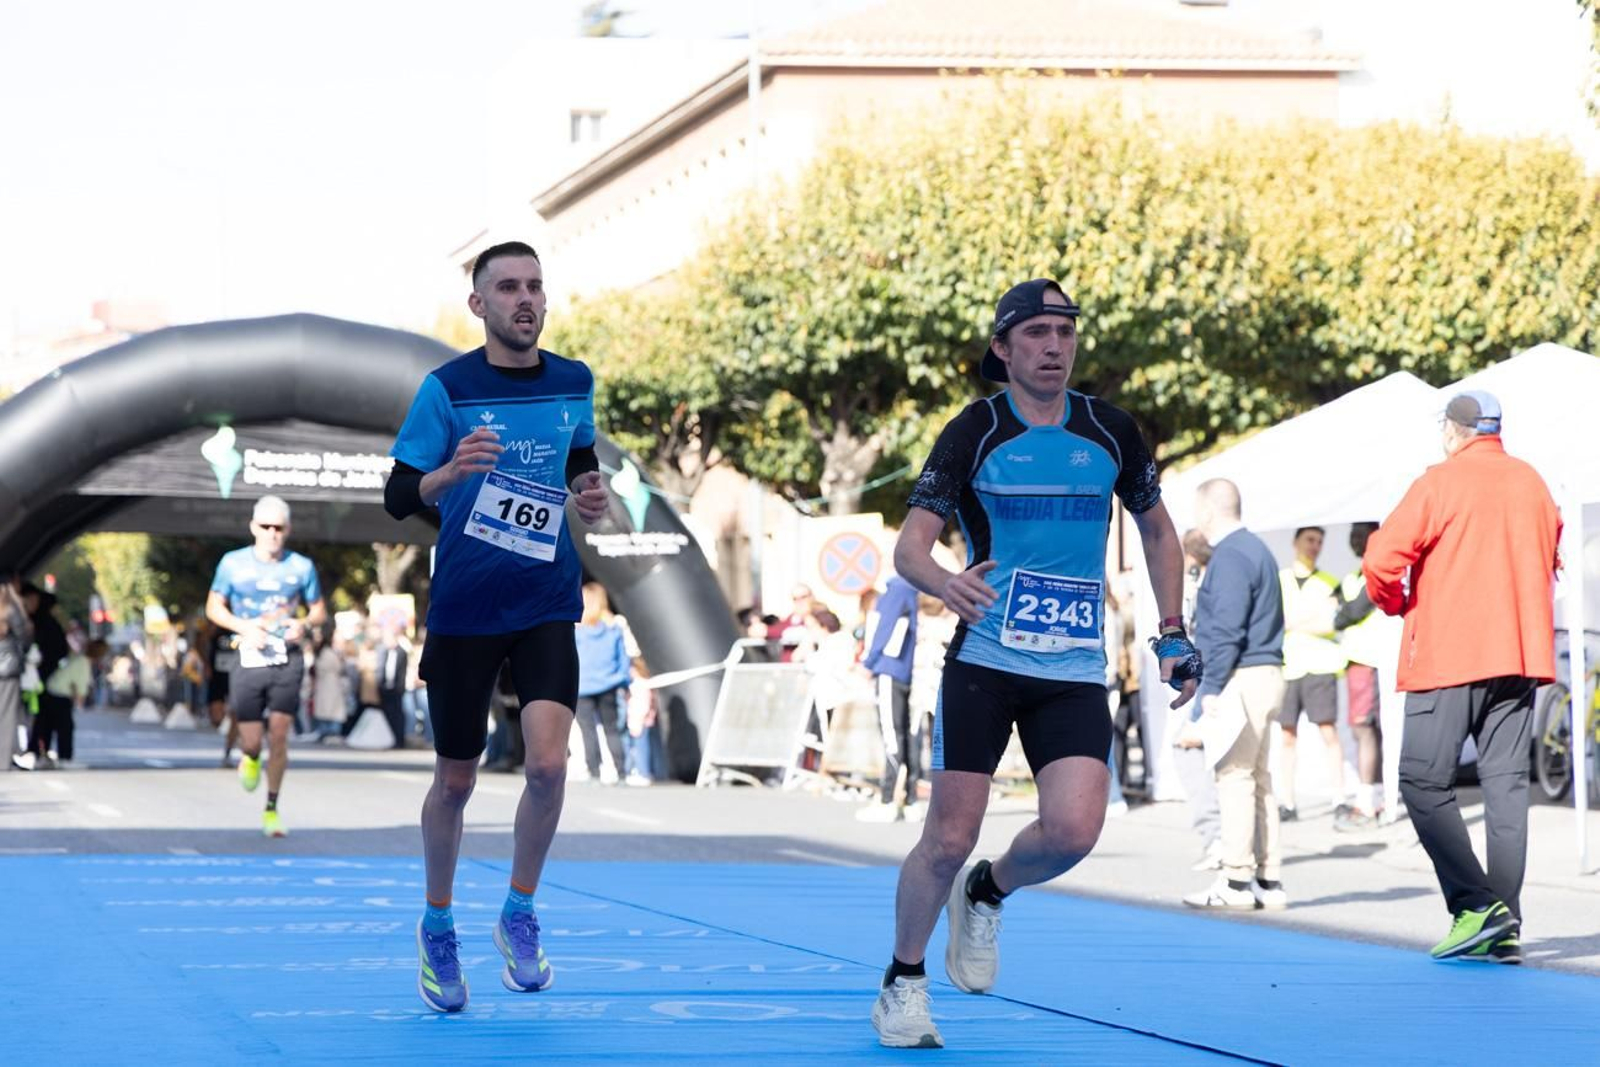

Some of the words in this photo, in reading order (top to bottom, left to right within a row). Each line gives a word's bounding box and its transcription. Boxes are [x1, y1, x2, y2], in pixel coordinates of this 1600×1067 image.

[498, 497, 550, 531] 169
[995, 498, 1054, 521] MEDIA
[1013, 593, 1094, 629] 2343
